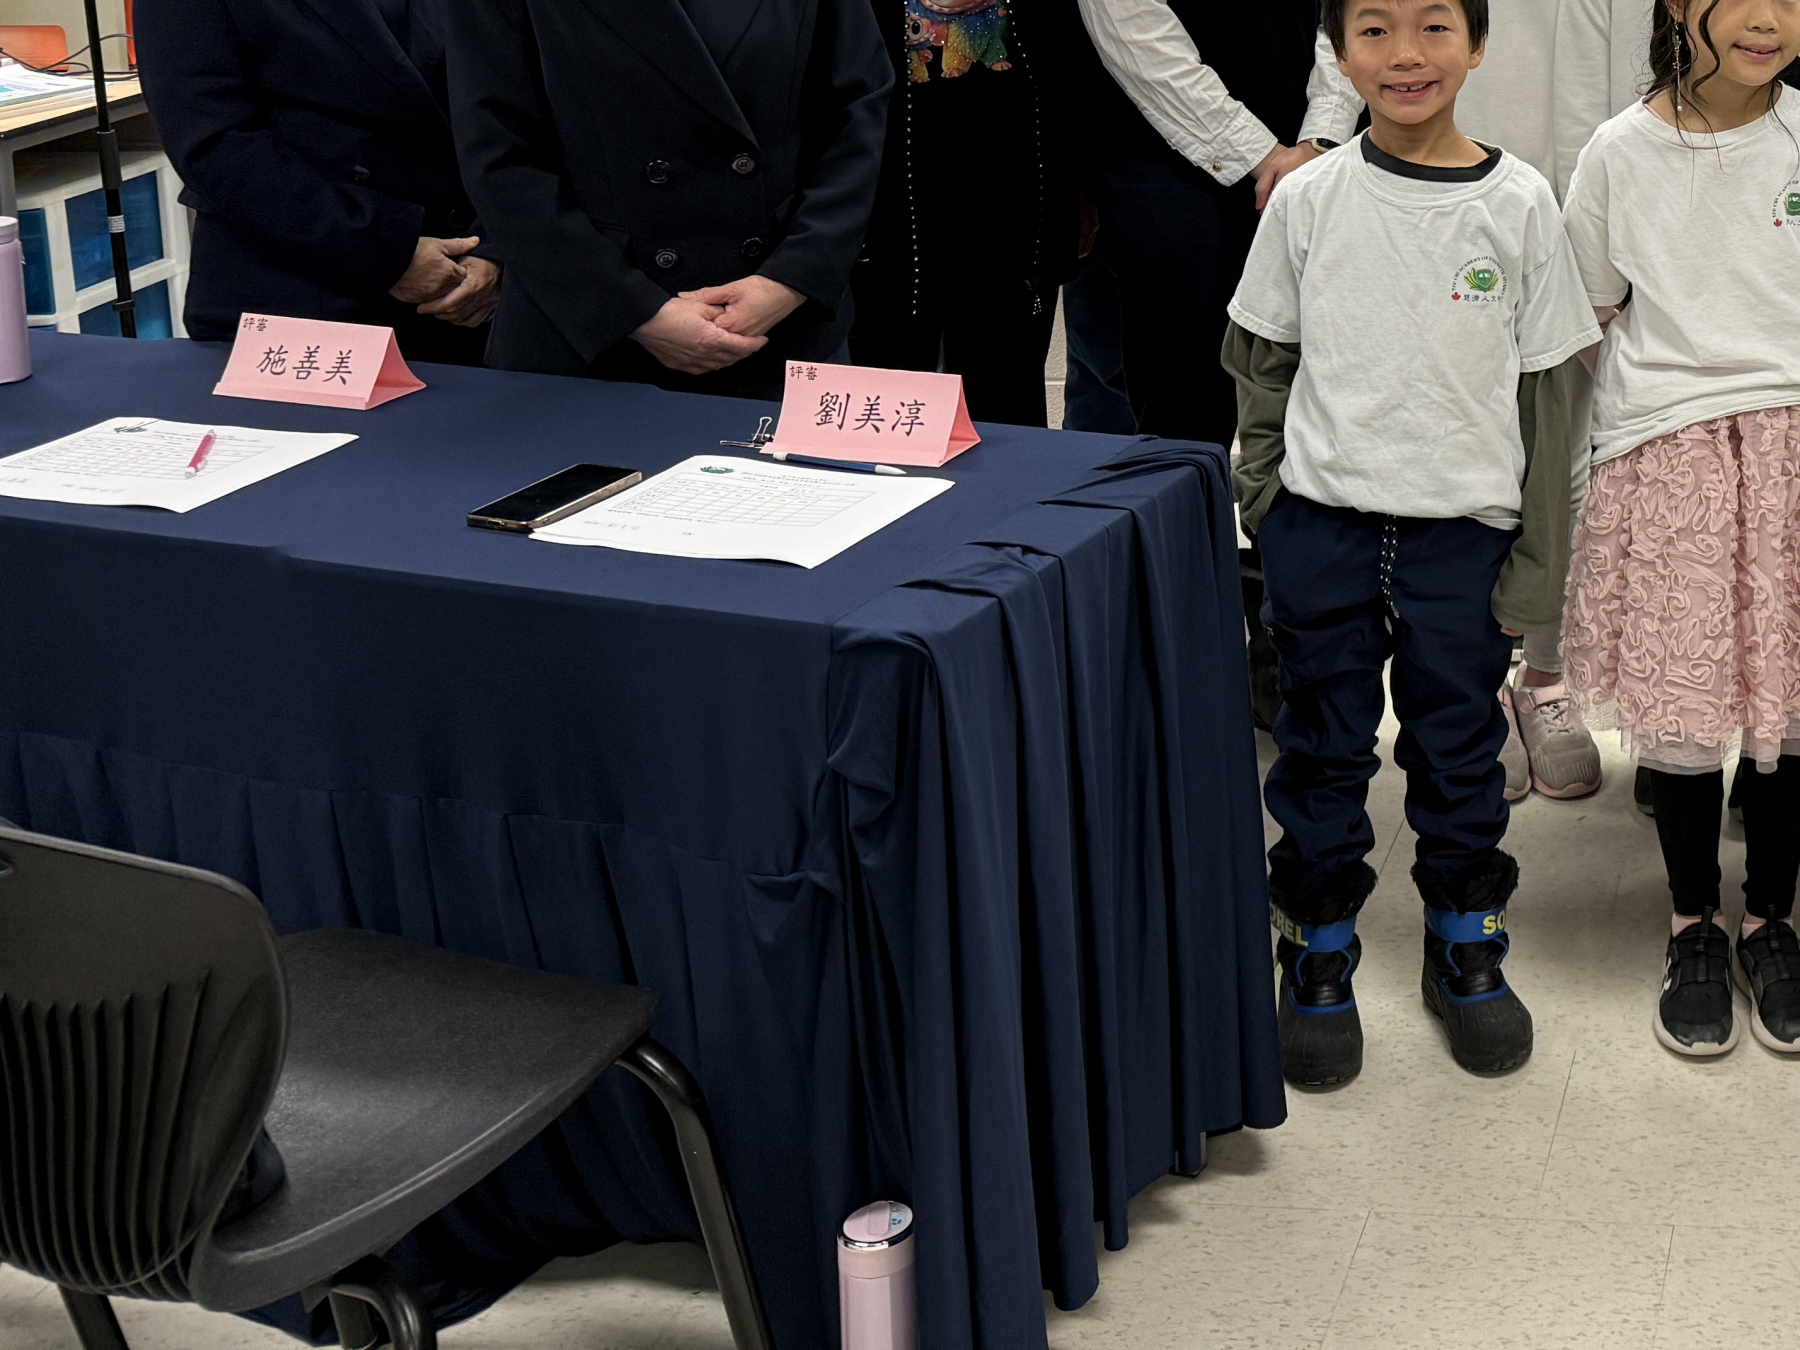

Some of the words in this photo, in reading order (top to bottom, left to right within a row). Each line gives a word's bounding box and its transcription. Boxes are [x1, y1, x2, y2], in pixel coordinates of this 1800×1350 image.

[243, 317, 268, 331] 評審
[256, 344, 353, 385] 施善美
[789, 366, 818, 381] 評審
[814, 391, 926, 437] 劉美淳
